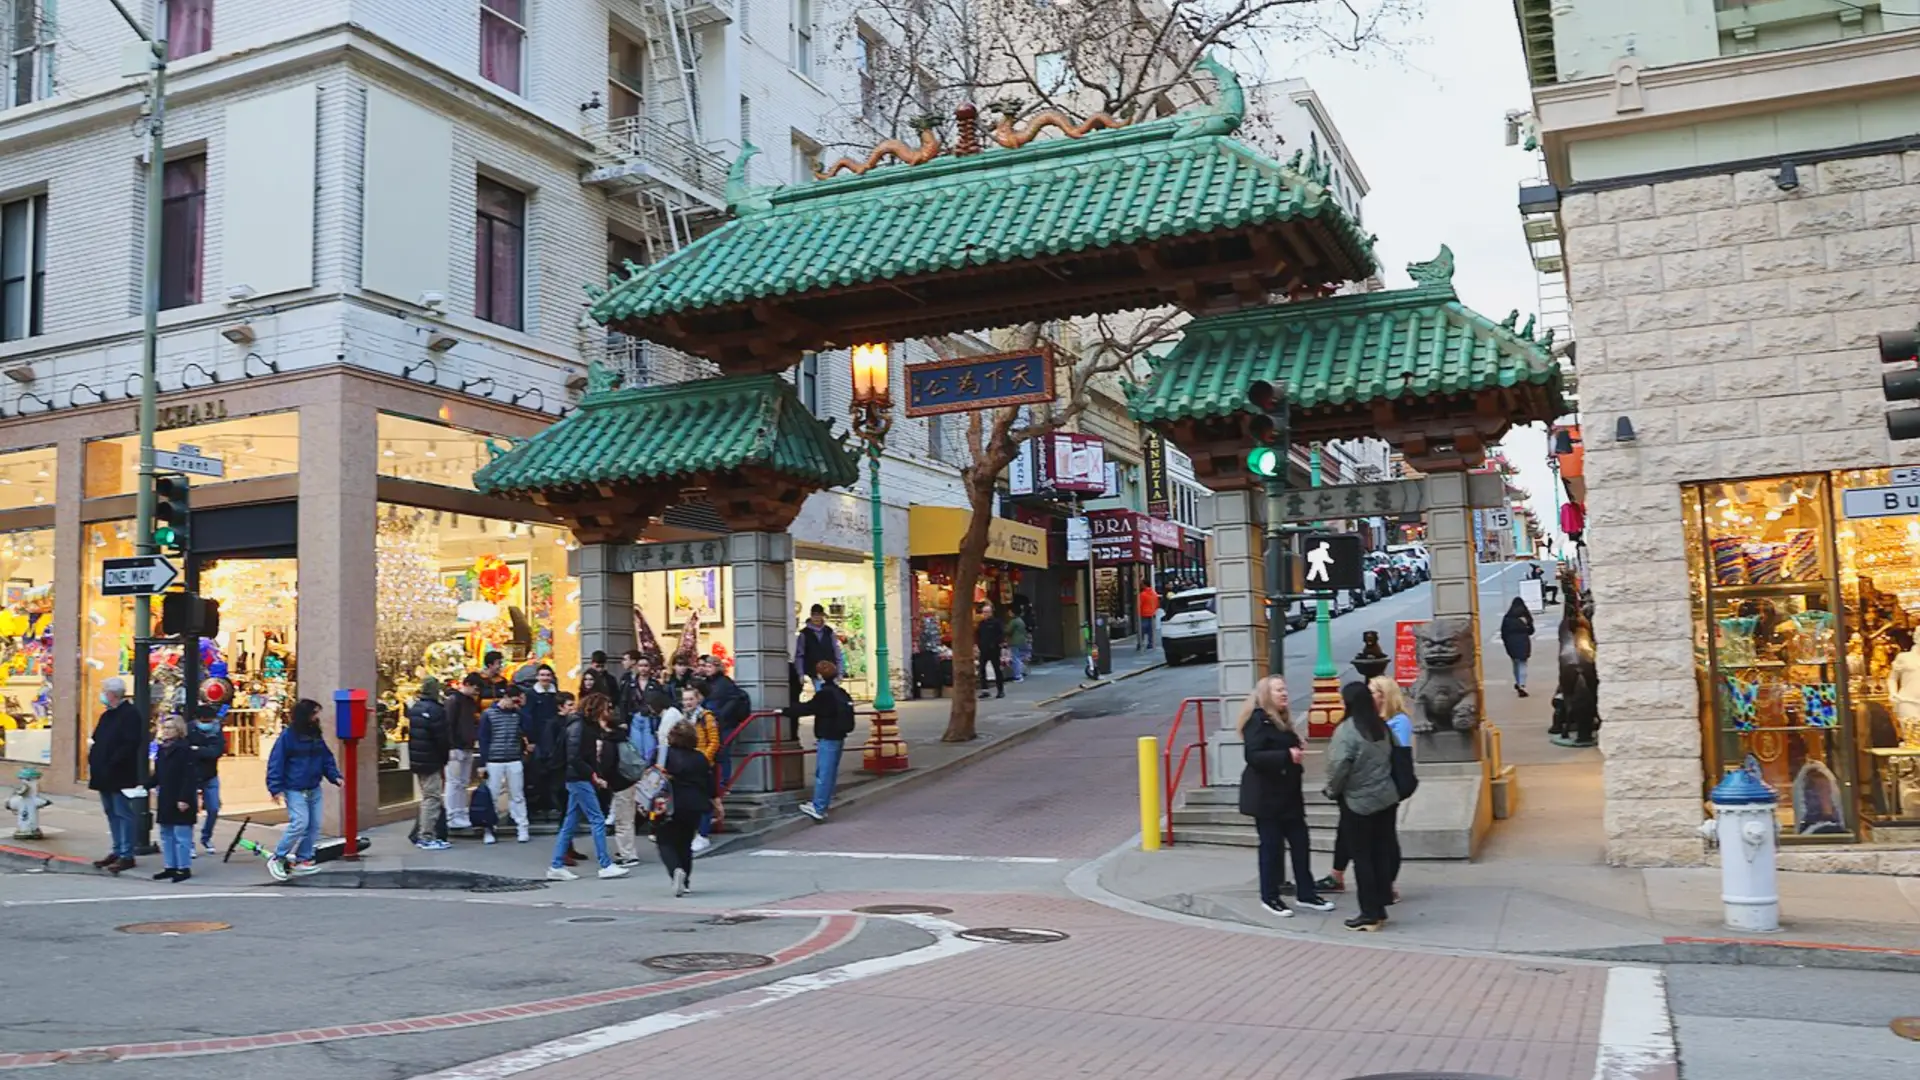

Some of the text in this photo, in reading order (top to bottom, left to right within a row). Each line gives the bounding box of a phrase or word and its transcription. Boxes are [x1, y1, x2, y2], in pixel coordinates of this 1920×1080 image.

[171, 455, 210, 472] Grant
[1149, 431, 1163, 500] VENEZIA
[1093, 518, 1132, 535] BRA
[1491, 513, 1509, 527] 15
[1010, 534, 1039, 556] GIFTS
[107, 569, 153, 585] ONE WAY
